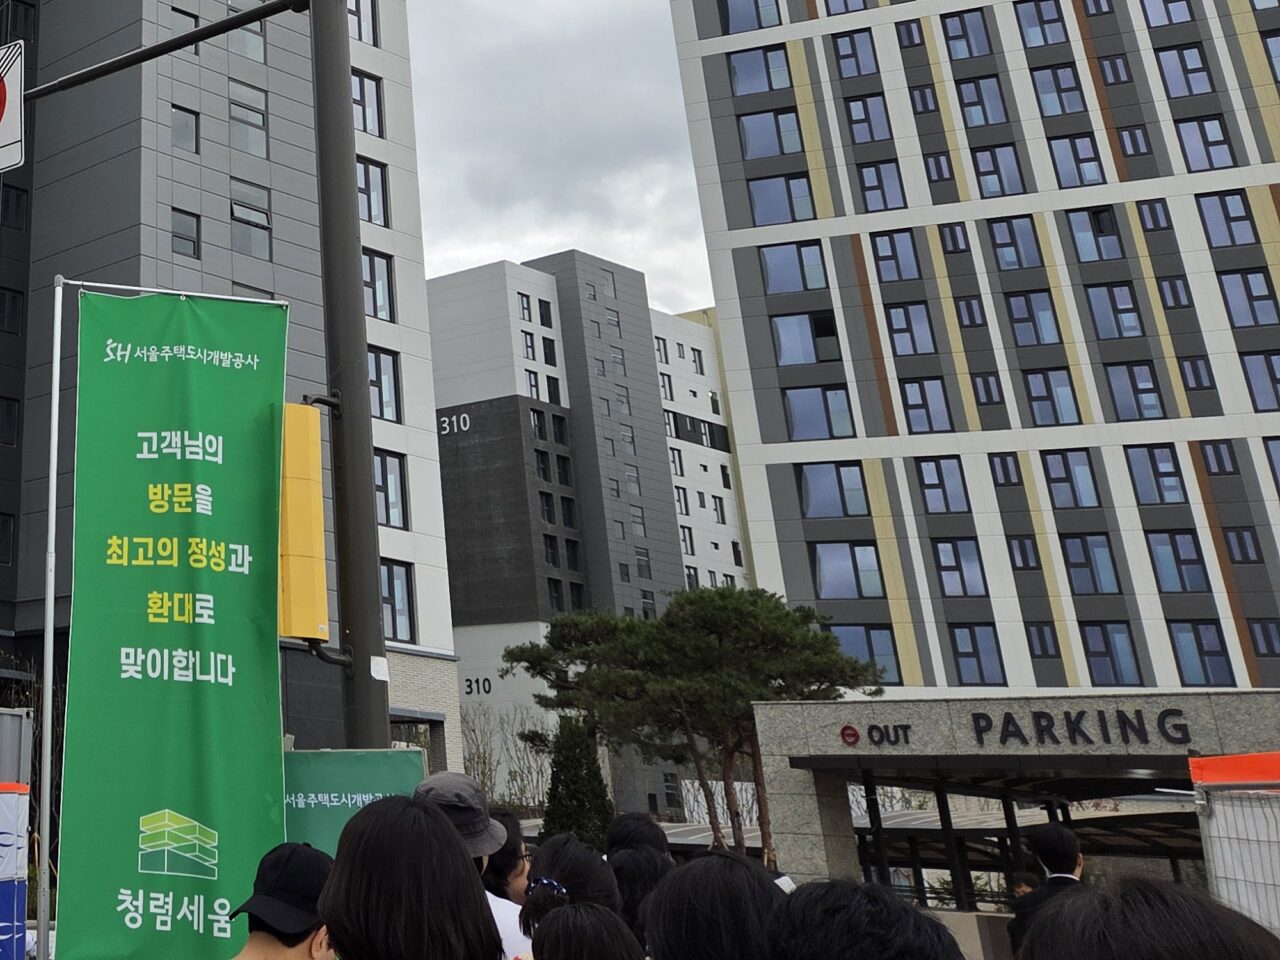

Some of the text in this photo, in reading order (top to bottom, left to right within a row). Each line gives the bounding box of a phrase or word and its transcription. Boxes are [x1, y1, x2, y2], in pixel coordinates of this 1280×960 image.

[103, 338, 259, 370] SH 서울주택도시개발공사
[440, 413, 470, 435] 310
[136, 431, 223, 464] 고객님의
[148, 483, 213, 516] 방문을
[106, 535, 252, 574] 최고의 정성과
[147, 591, 215, 625] 환대로
[120, 647, 236, 686] 맞이합니다
[464, 677, 492, 695] 310
[867, 708, 1192, 746] OUT PARKING
[116, 888, 234, 938] 청렴세움
